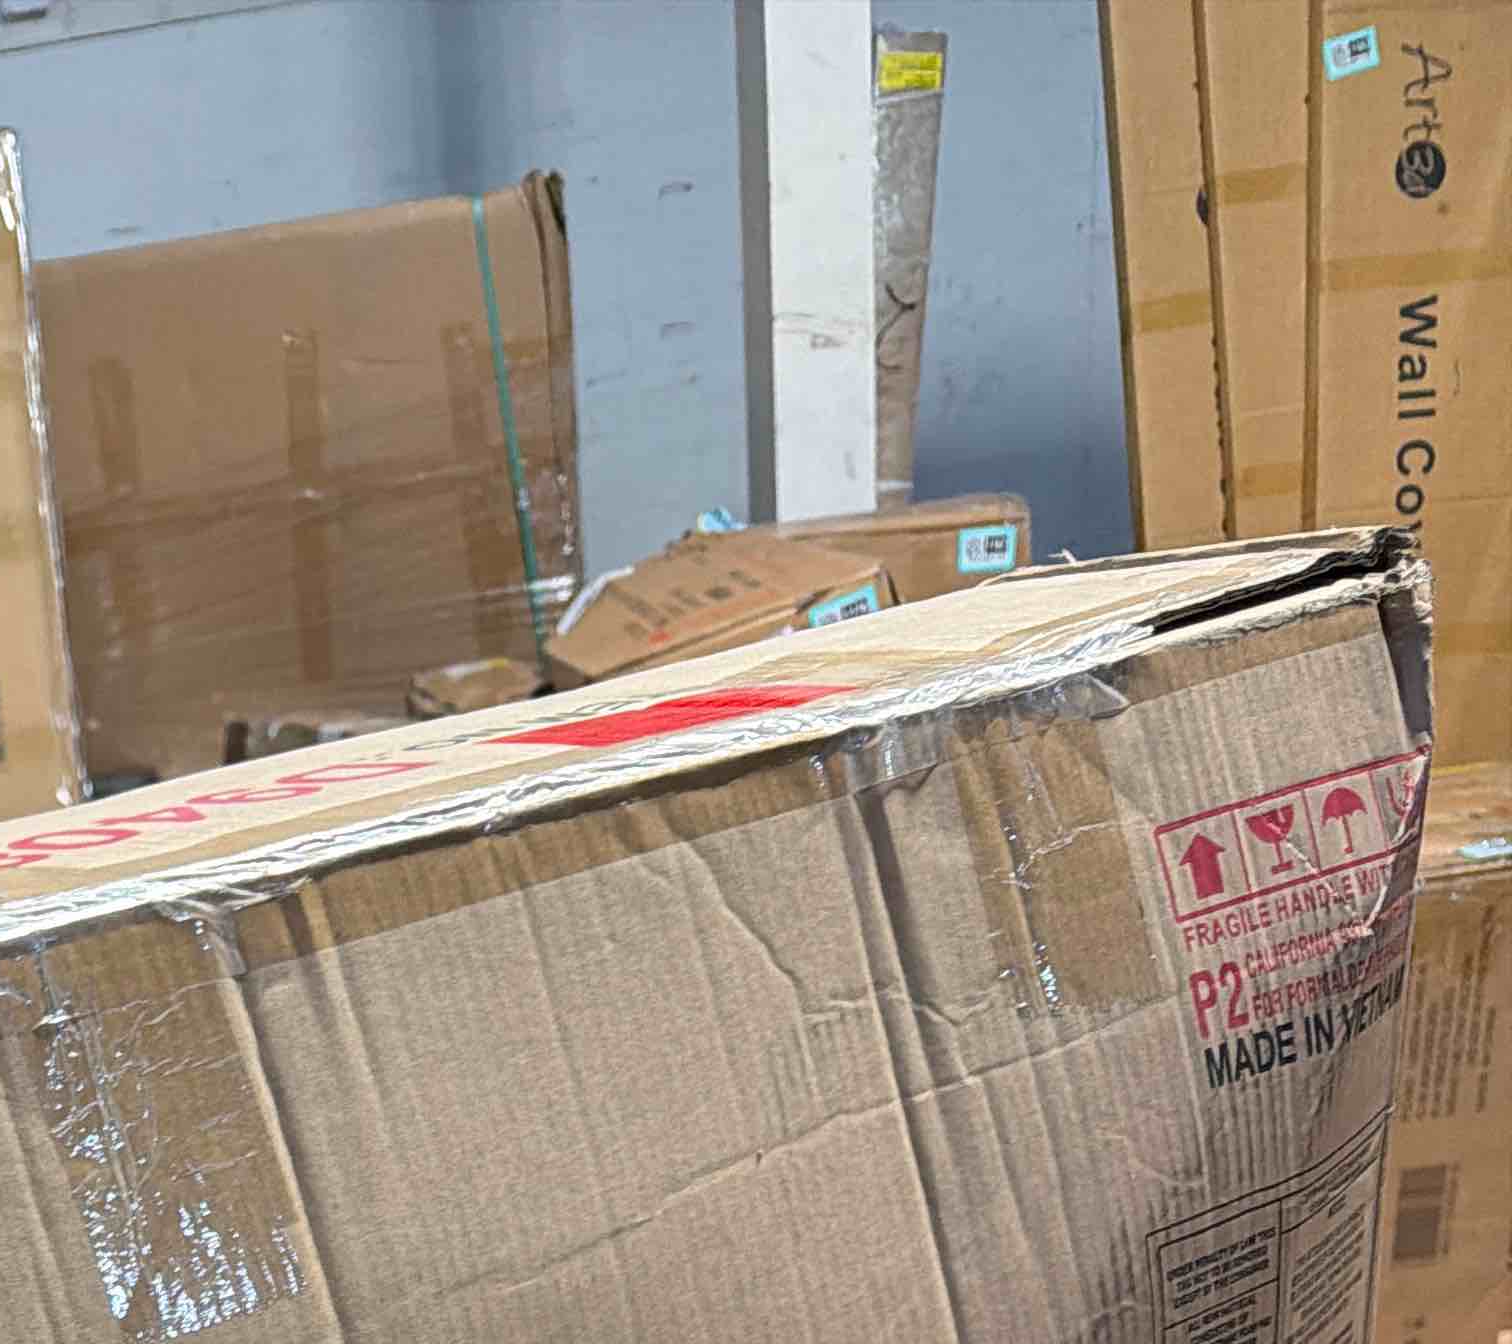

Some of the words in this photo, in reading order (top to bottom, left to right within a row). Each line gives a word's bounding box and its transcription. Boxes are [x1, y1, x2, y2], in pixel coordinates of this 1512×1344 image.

[1398, 294, 1439, 420] Wall
[1183, 903, 1274, 953] FRAGILE
[1190, 960, 1250, 1040] P2
[1204, 1021, 1299, 1089] MADE
[1303, 1007, 1336, 1057] IN
